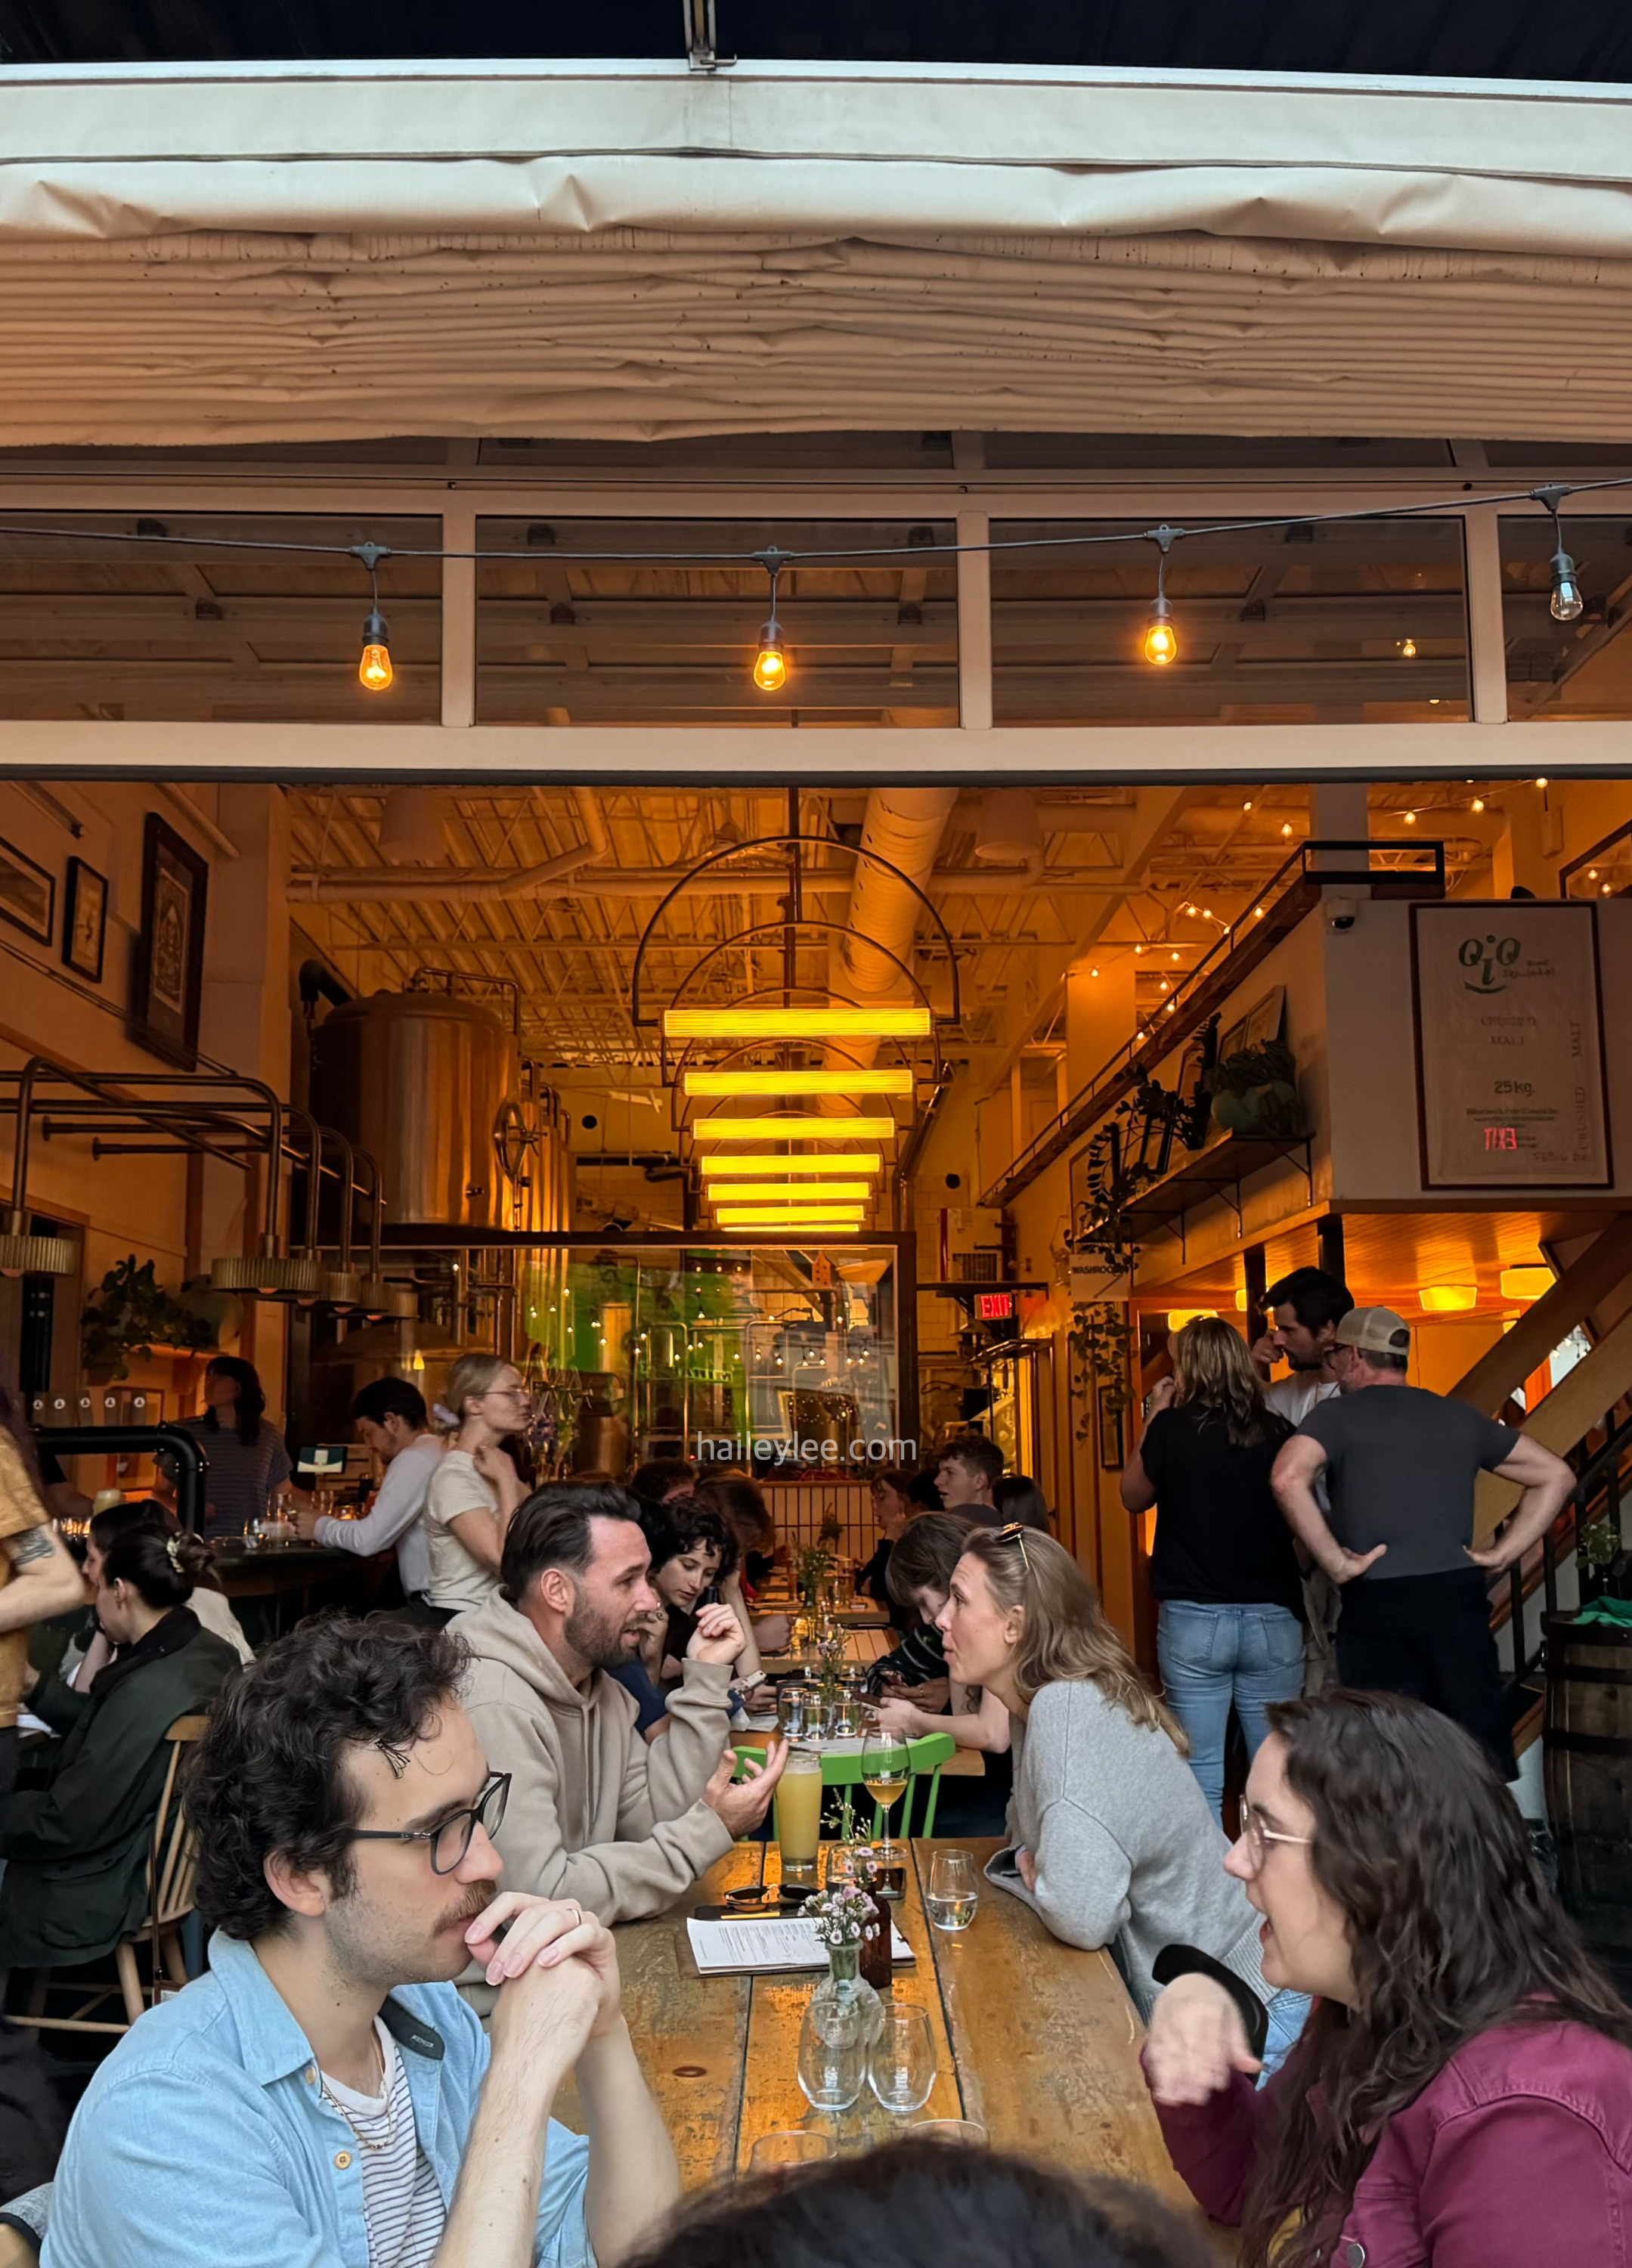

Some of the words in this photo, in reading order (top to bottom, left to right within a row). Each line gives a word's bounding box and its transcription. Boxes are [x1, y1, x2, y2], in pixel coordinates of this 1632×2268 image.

[1569, 1020, 1582, 1057] MALT
[1575, 1086, 1588, 1150] CRUSHED
[980, 1294, 1009, 1318] EXIT
